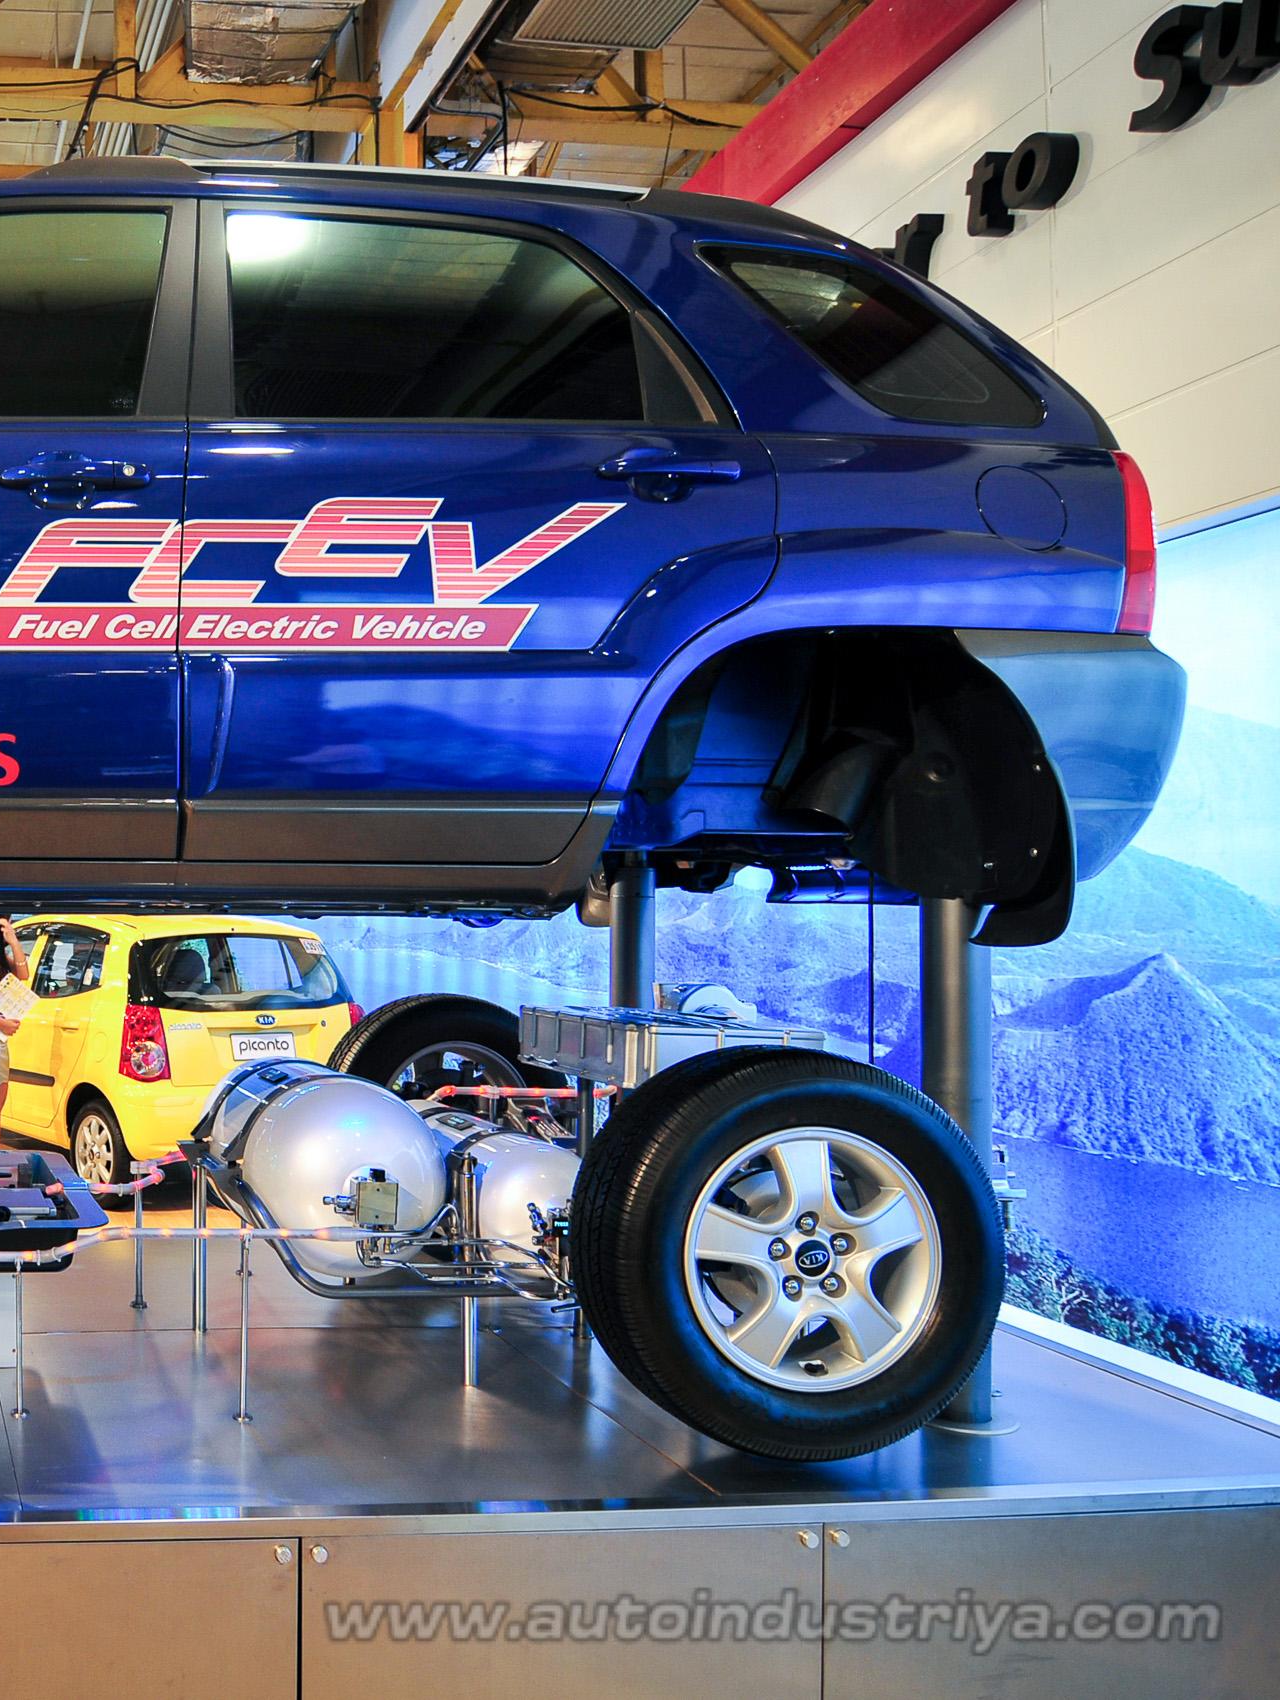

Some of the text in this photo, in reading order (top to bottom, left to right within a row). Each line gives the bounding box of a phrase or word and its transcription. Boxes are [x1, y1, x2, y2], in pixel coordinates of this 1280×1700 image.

[7, 613, 487, 640] Fuel Cell Electric Vehicle
[239, 1038, 290, 1055] picanto
